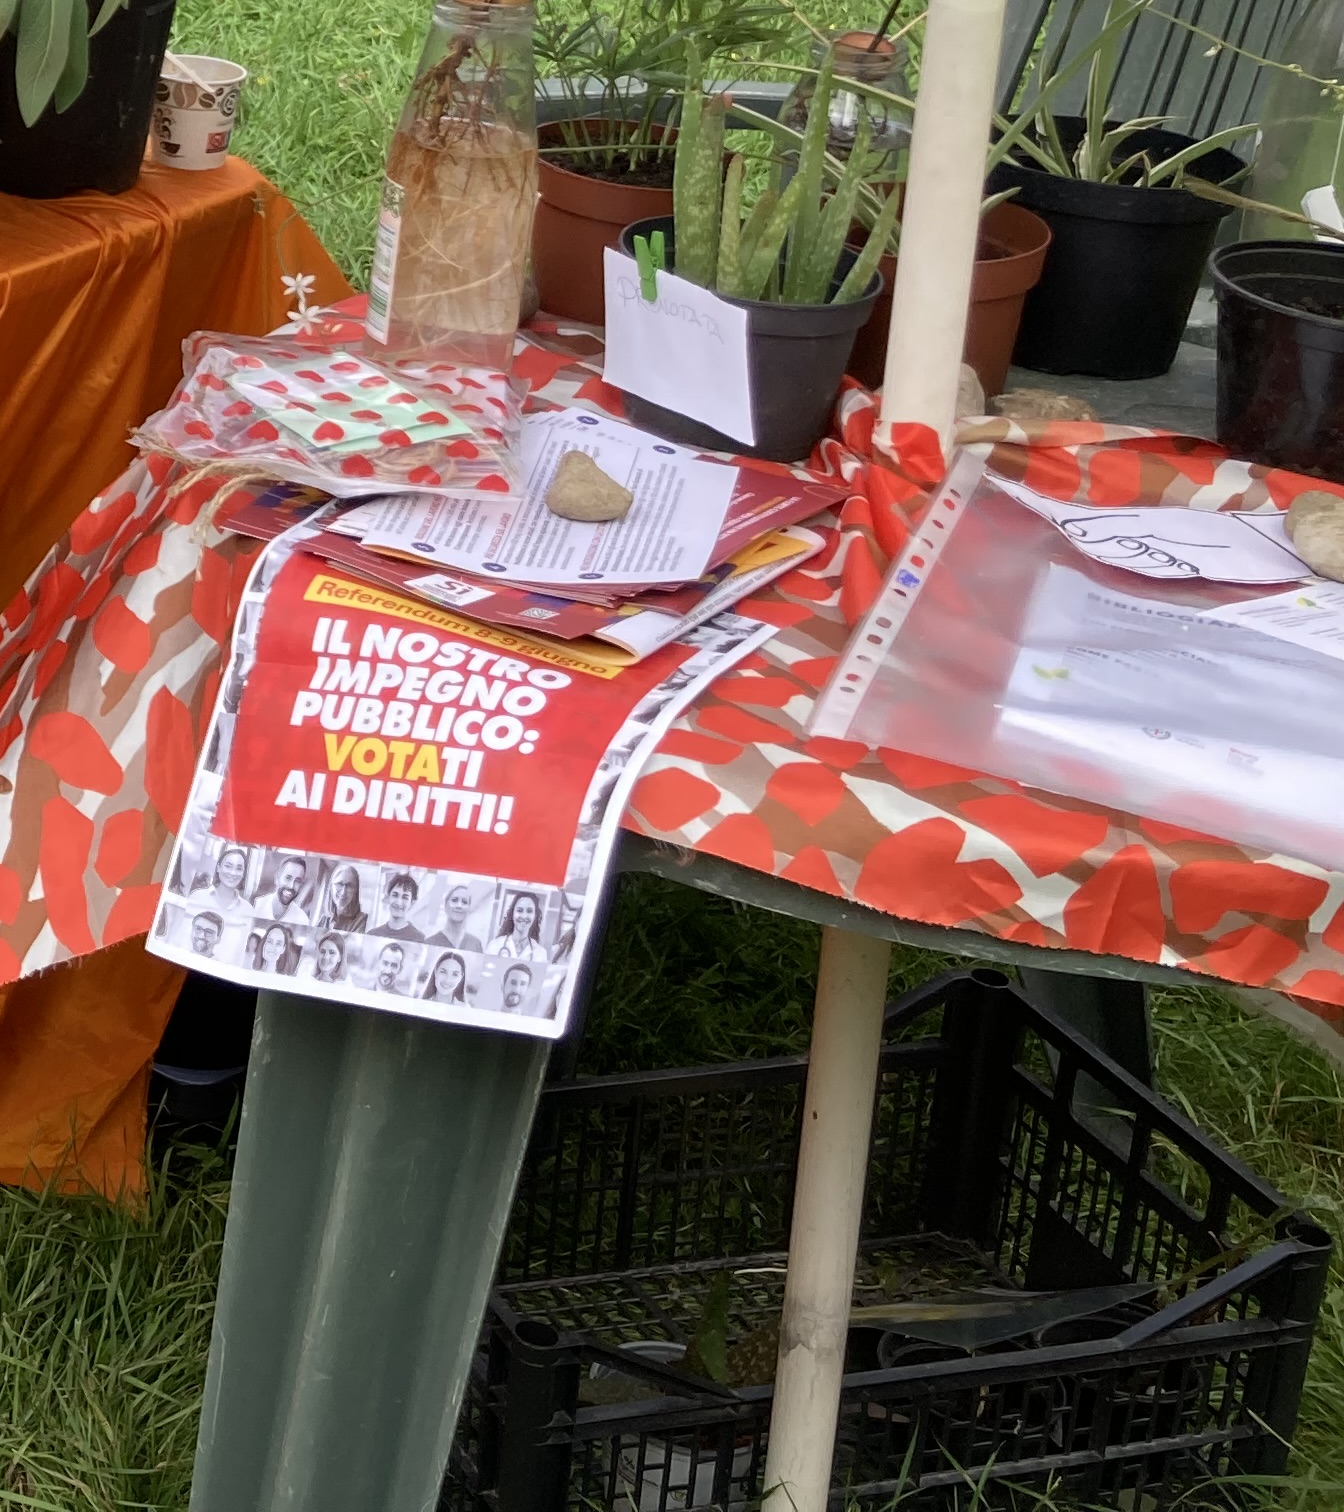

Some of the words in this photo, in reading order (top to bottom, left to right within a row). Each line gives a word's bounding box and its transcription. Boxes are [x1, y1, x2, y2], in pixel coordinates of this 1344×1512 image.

[616, 276, 725, 346] PRNOTATA
[311, 617, 351, 656] IL
[359, 623, 573, 690] NOSTRO
[316, 580, 471, 633] Referendum
[473, 628, 519, 647] 8-9
[517, 642, 608, 675] giugno
[308, 656, 547, 716] IMPEGNO
[289, 690, 541, 755] PUBBLICO:
[323, 733, 485, 788] VOTATI
[274, 769, 328, 811] AI
[331, 775, 516, 835] DIRITTI!
